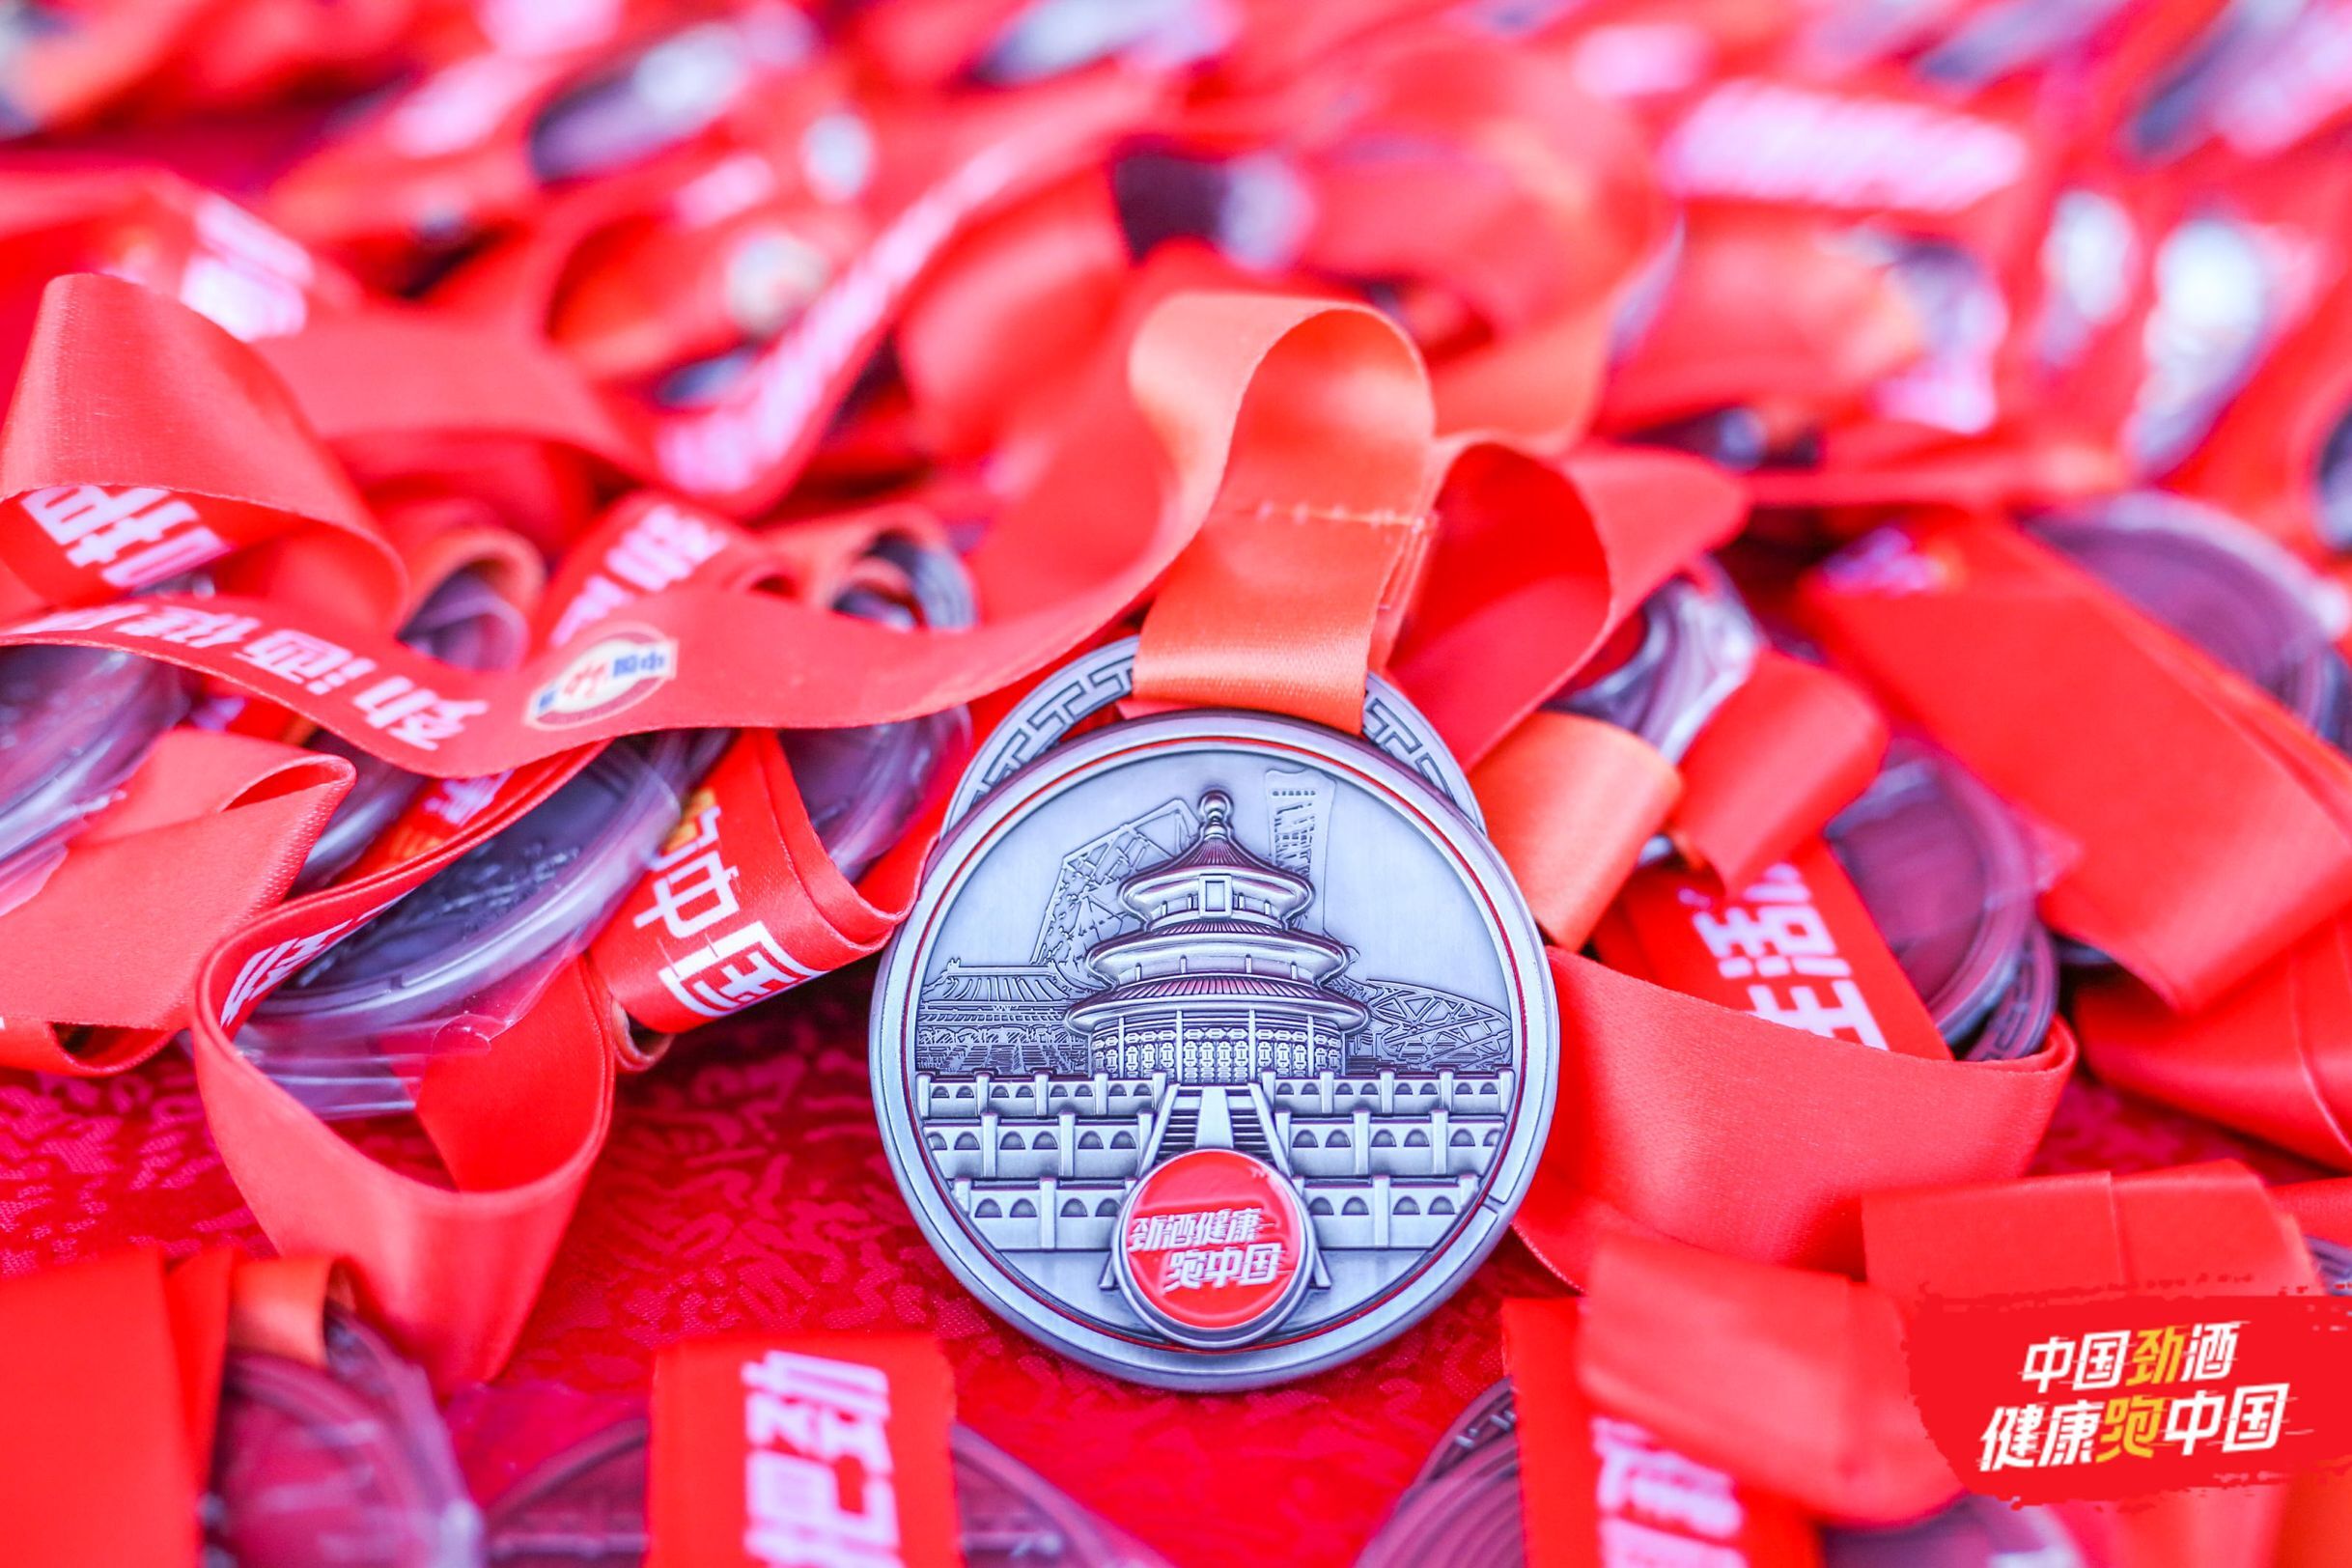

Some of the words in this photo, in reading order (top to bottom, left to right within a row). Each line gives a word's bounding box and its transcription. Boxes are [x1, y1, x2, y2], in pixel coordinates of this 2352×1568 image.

[1128, 1207, 1263, 1251] 劲酒健康
[1163, 1242, 1284, 1295] 跑中国
